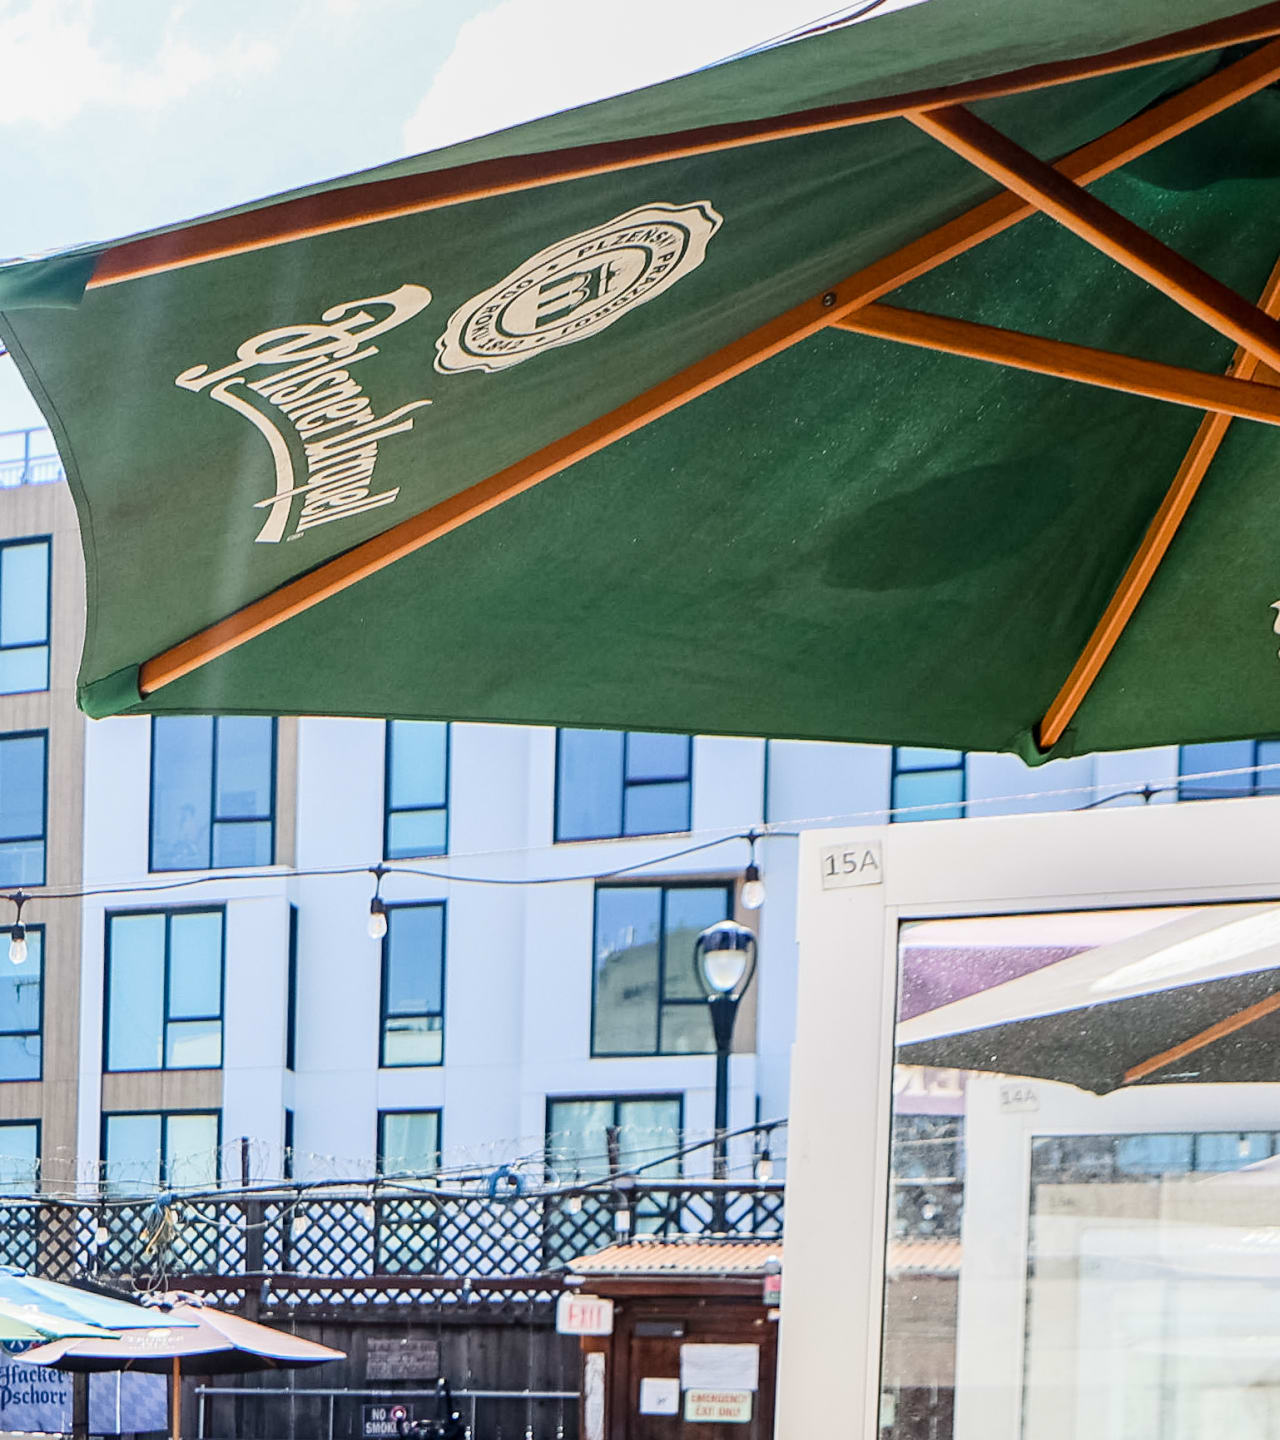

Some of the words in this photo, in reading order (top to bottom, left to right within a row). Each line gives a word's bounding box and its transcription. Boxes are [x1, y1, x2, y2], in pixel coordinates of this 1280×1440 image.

[824, 849, 879, 877] 15A
[568, 1302, 603, 1329] EXIT
[371, 1408, 387, 1421] NO
